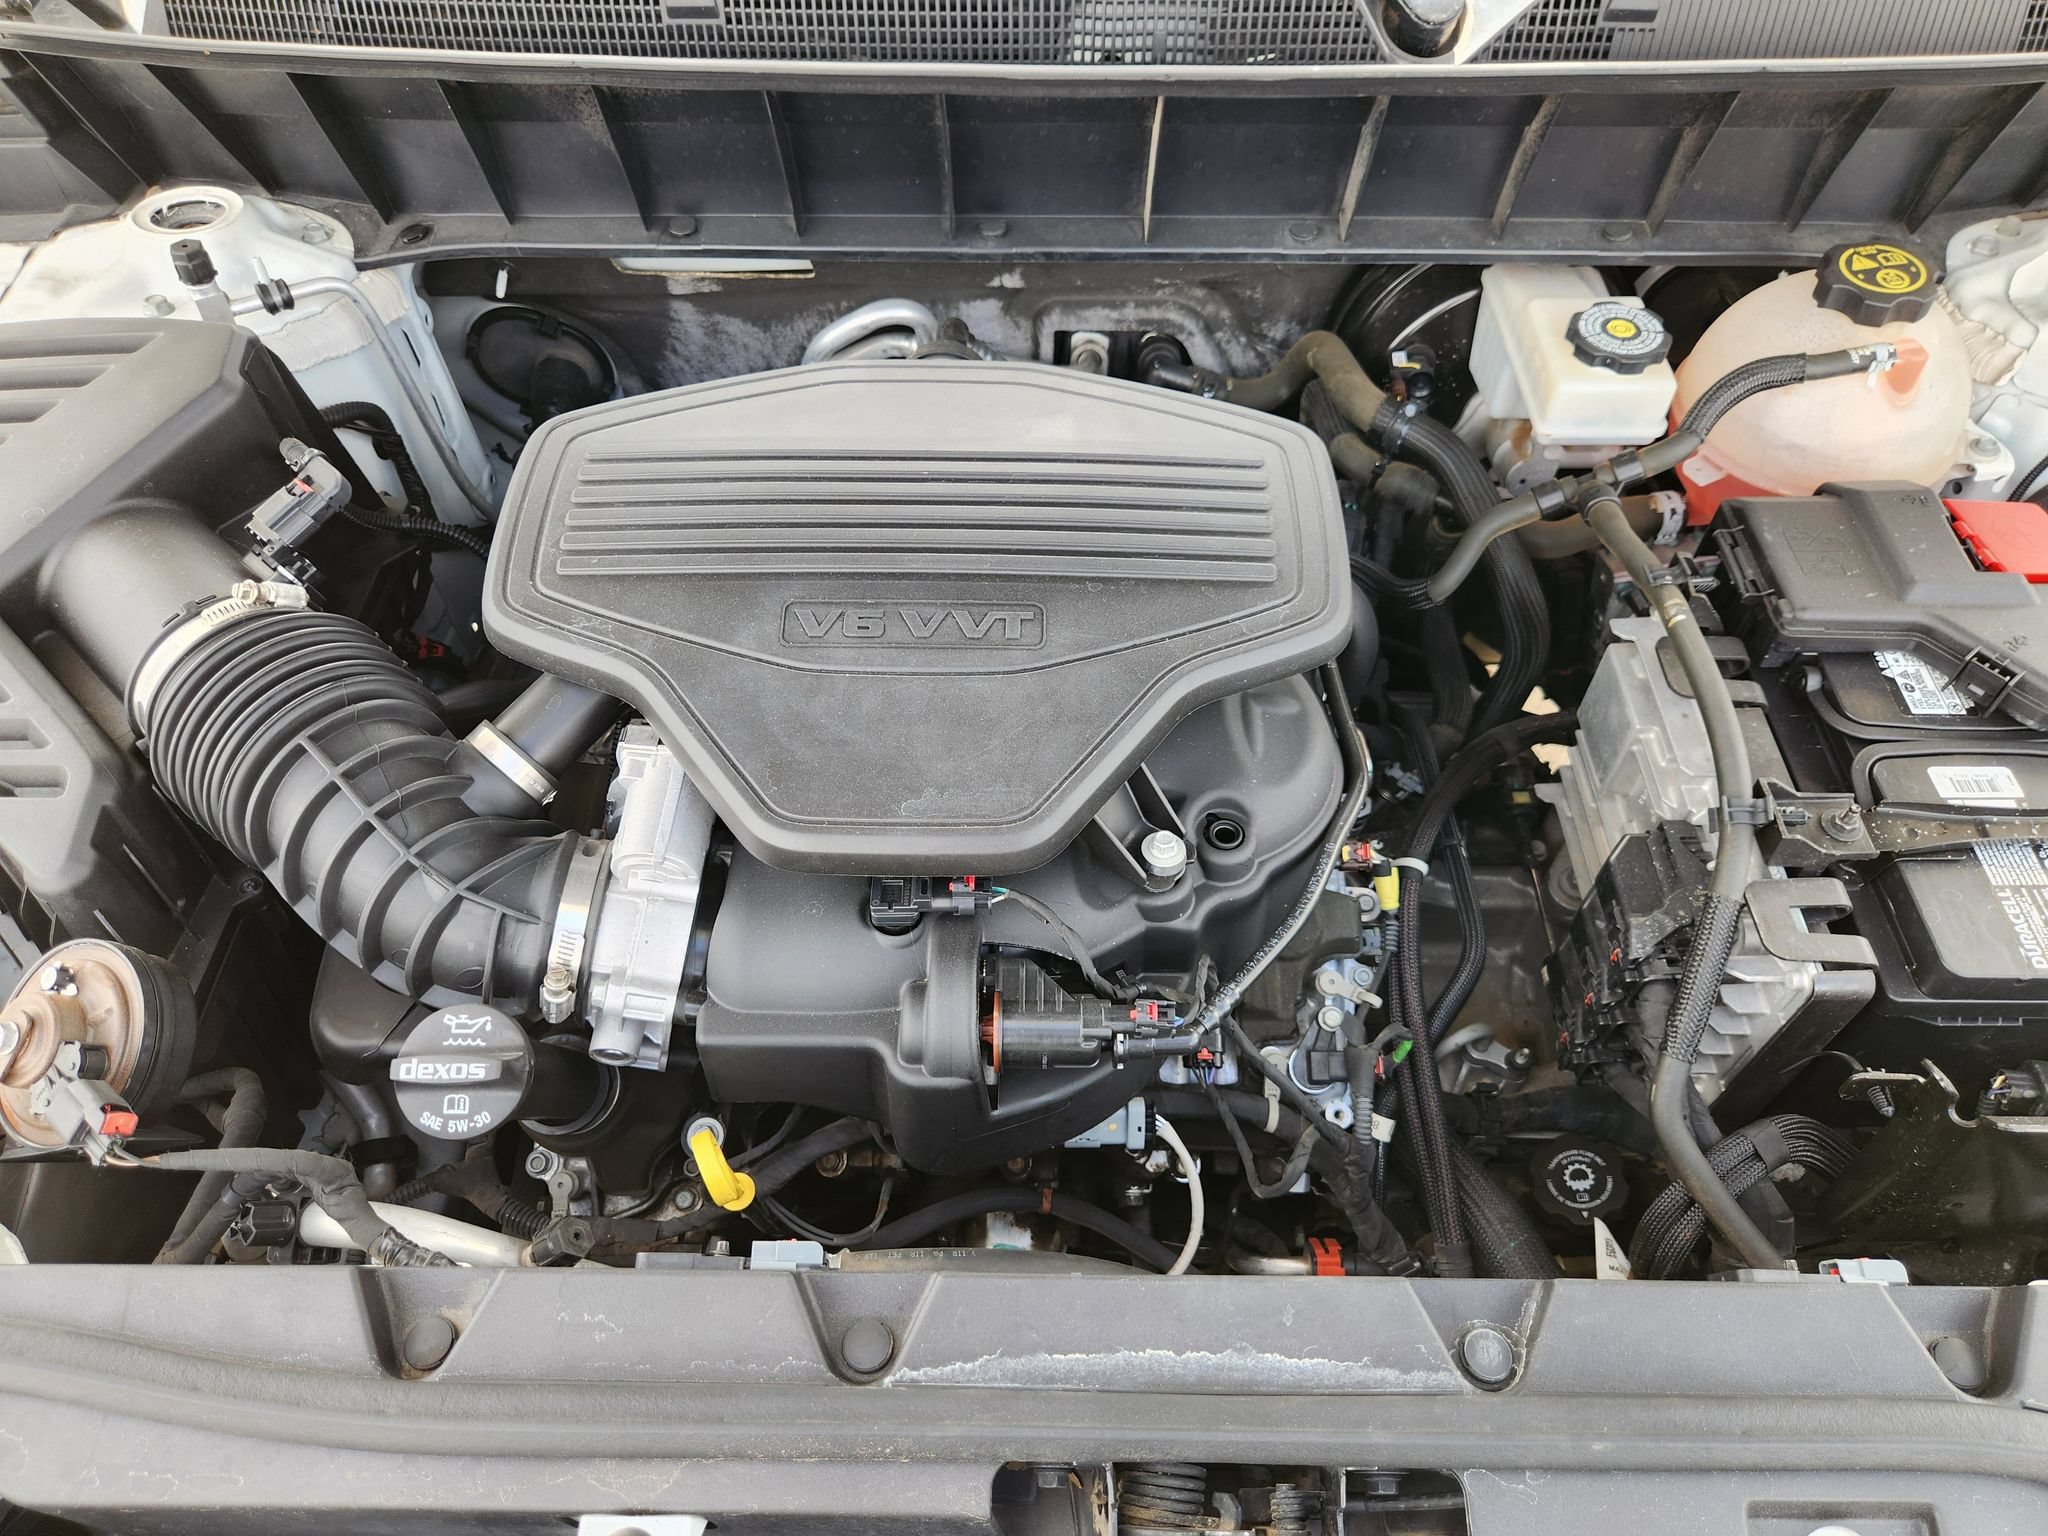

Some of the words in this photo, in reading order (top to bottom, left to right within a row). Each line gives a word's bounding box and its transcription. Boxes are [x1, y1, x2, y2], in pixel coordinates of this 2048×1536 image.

[793, 608, 886, 639] V6
[899, 608, 1036, 640] VVT
[1996, 887, 2048, 969] DURACELL
[399, 1058, 487, 1080] dexos
[420, 1111, 443, 1131] SAE
[447, 1111, 492, 1133] 5W-30
